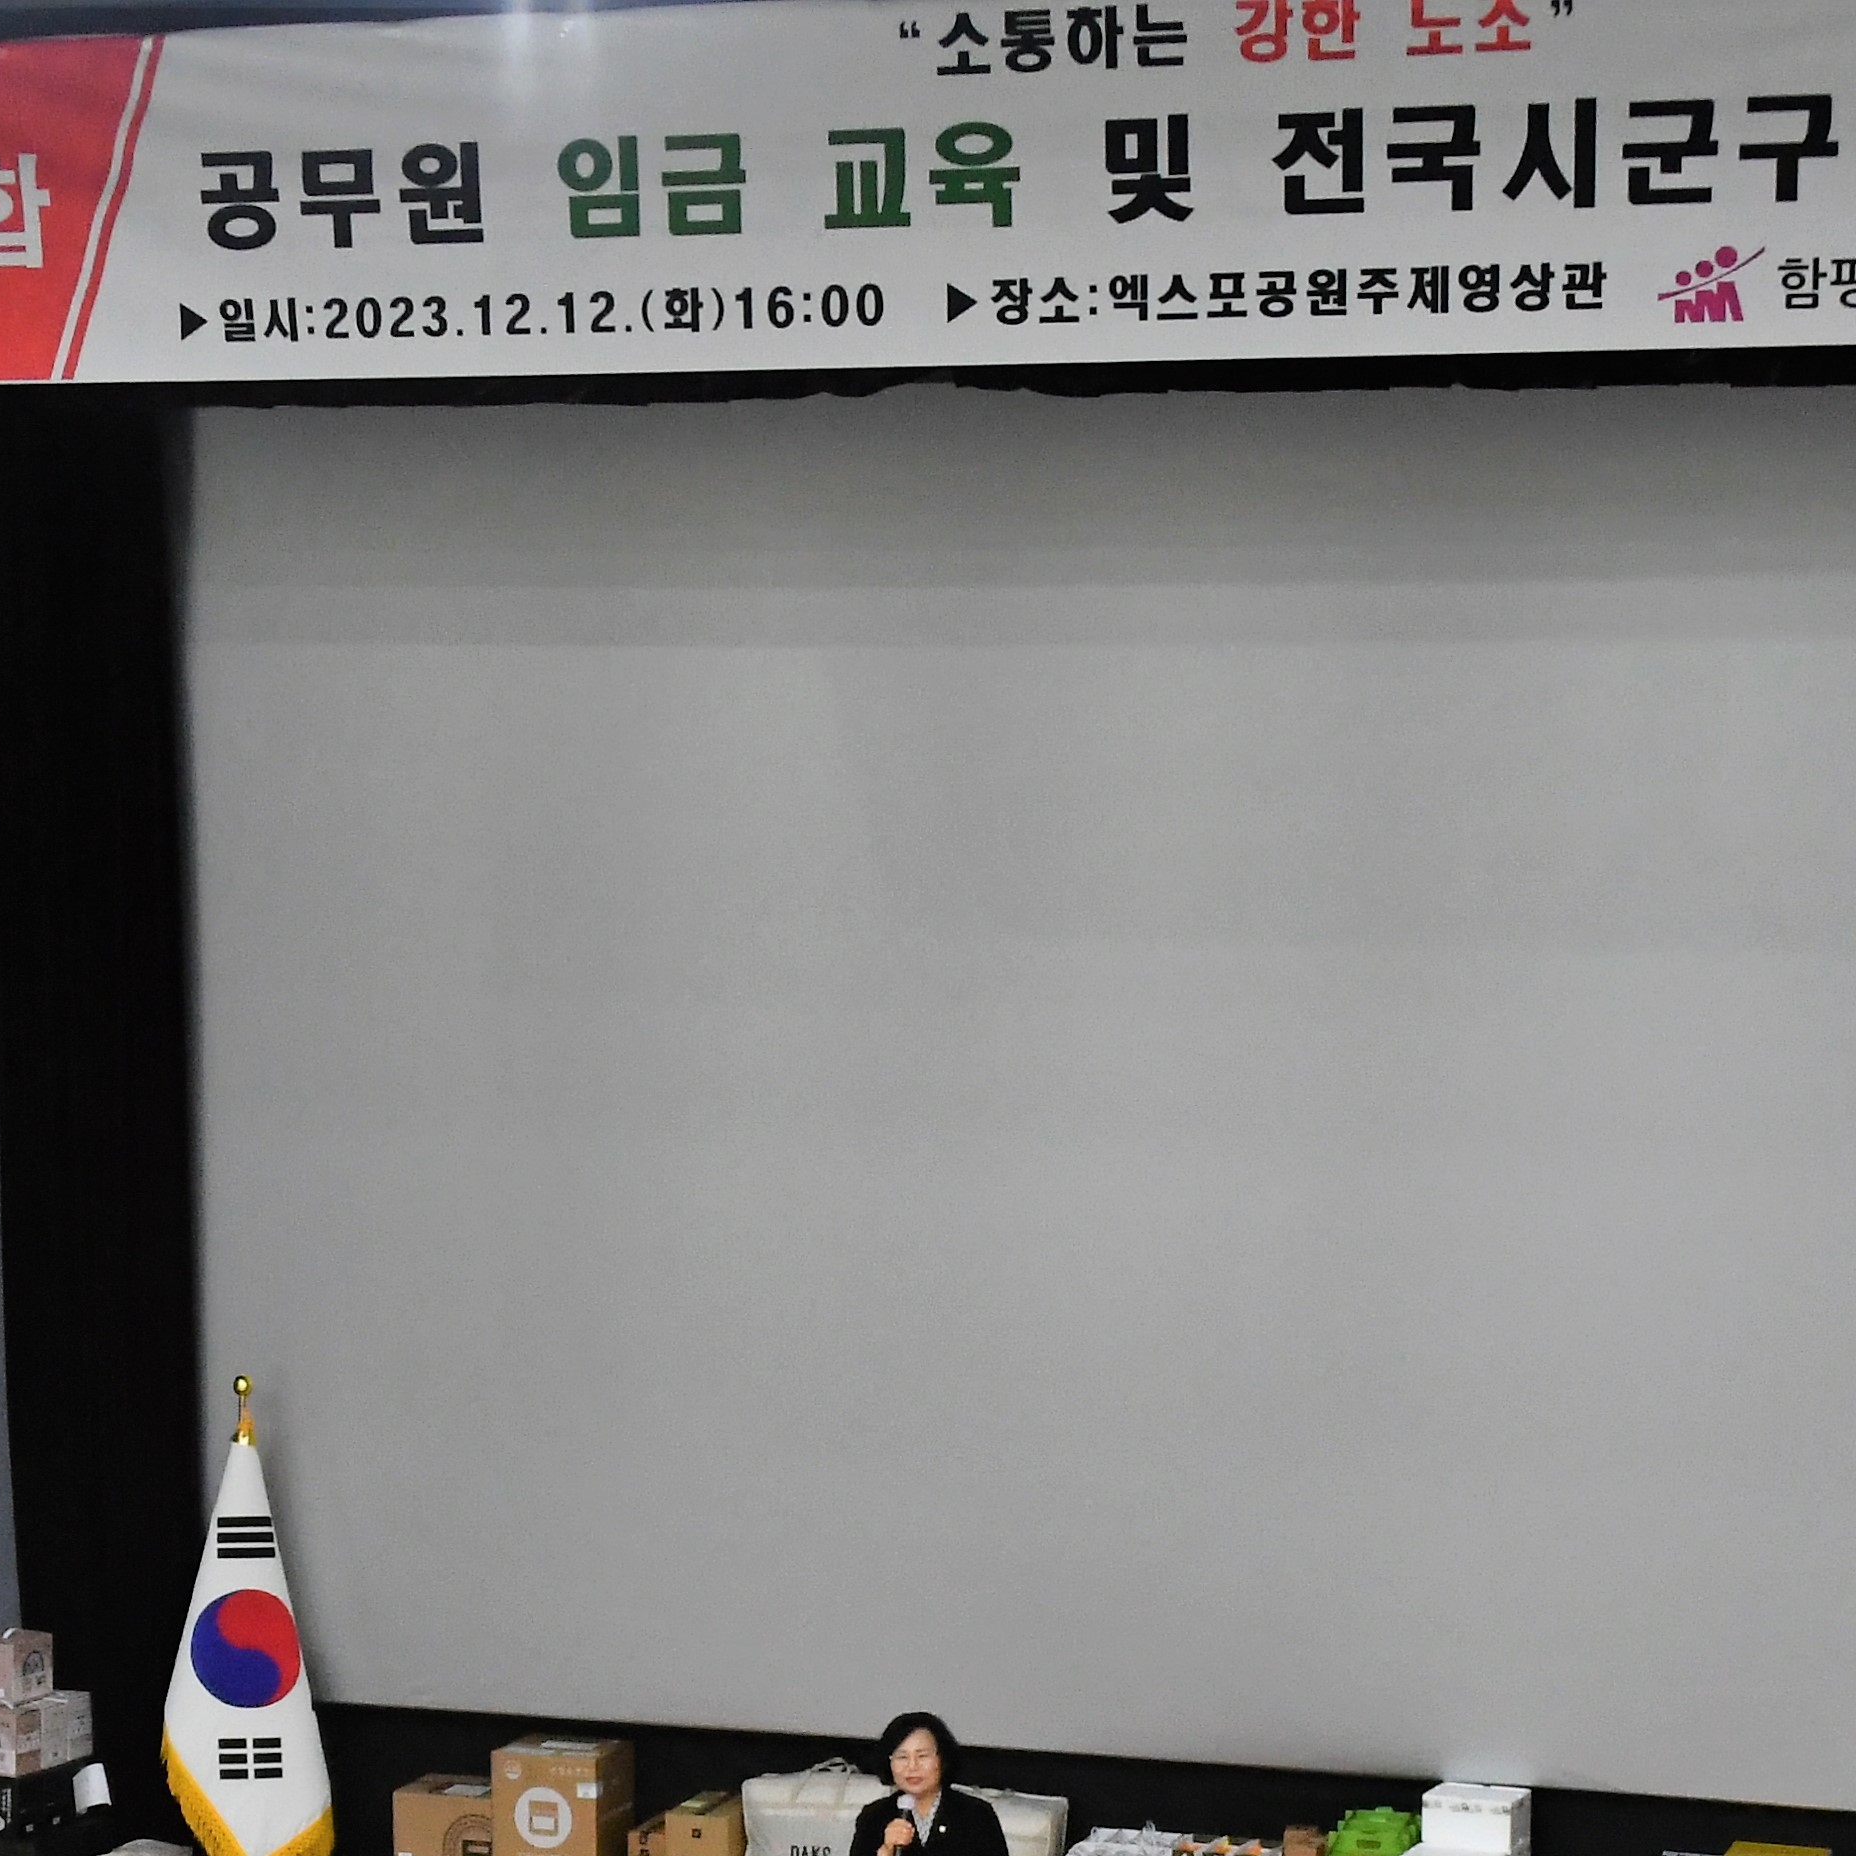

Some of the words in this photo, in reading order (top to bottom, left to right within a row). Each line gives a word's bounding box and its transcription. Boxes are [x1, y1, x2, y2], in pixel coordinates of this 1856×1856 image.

[1234, 0, 1361, 63] 강한
[200, 141, 485, 251] 공무원
[557, 132, 747, 239] 임금
[824, 121, 1021, 230] 교육
[1104, 113, 1195, 224] 및
[1271, 93, 1840, 216] 전국시군구
